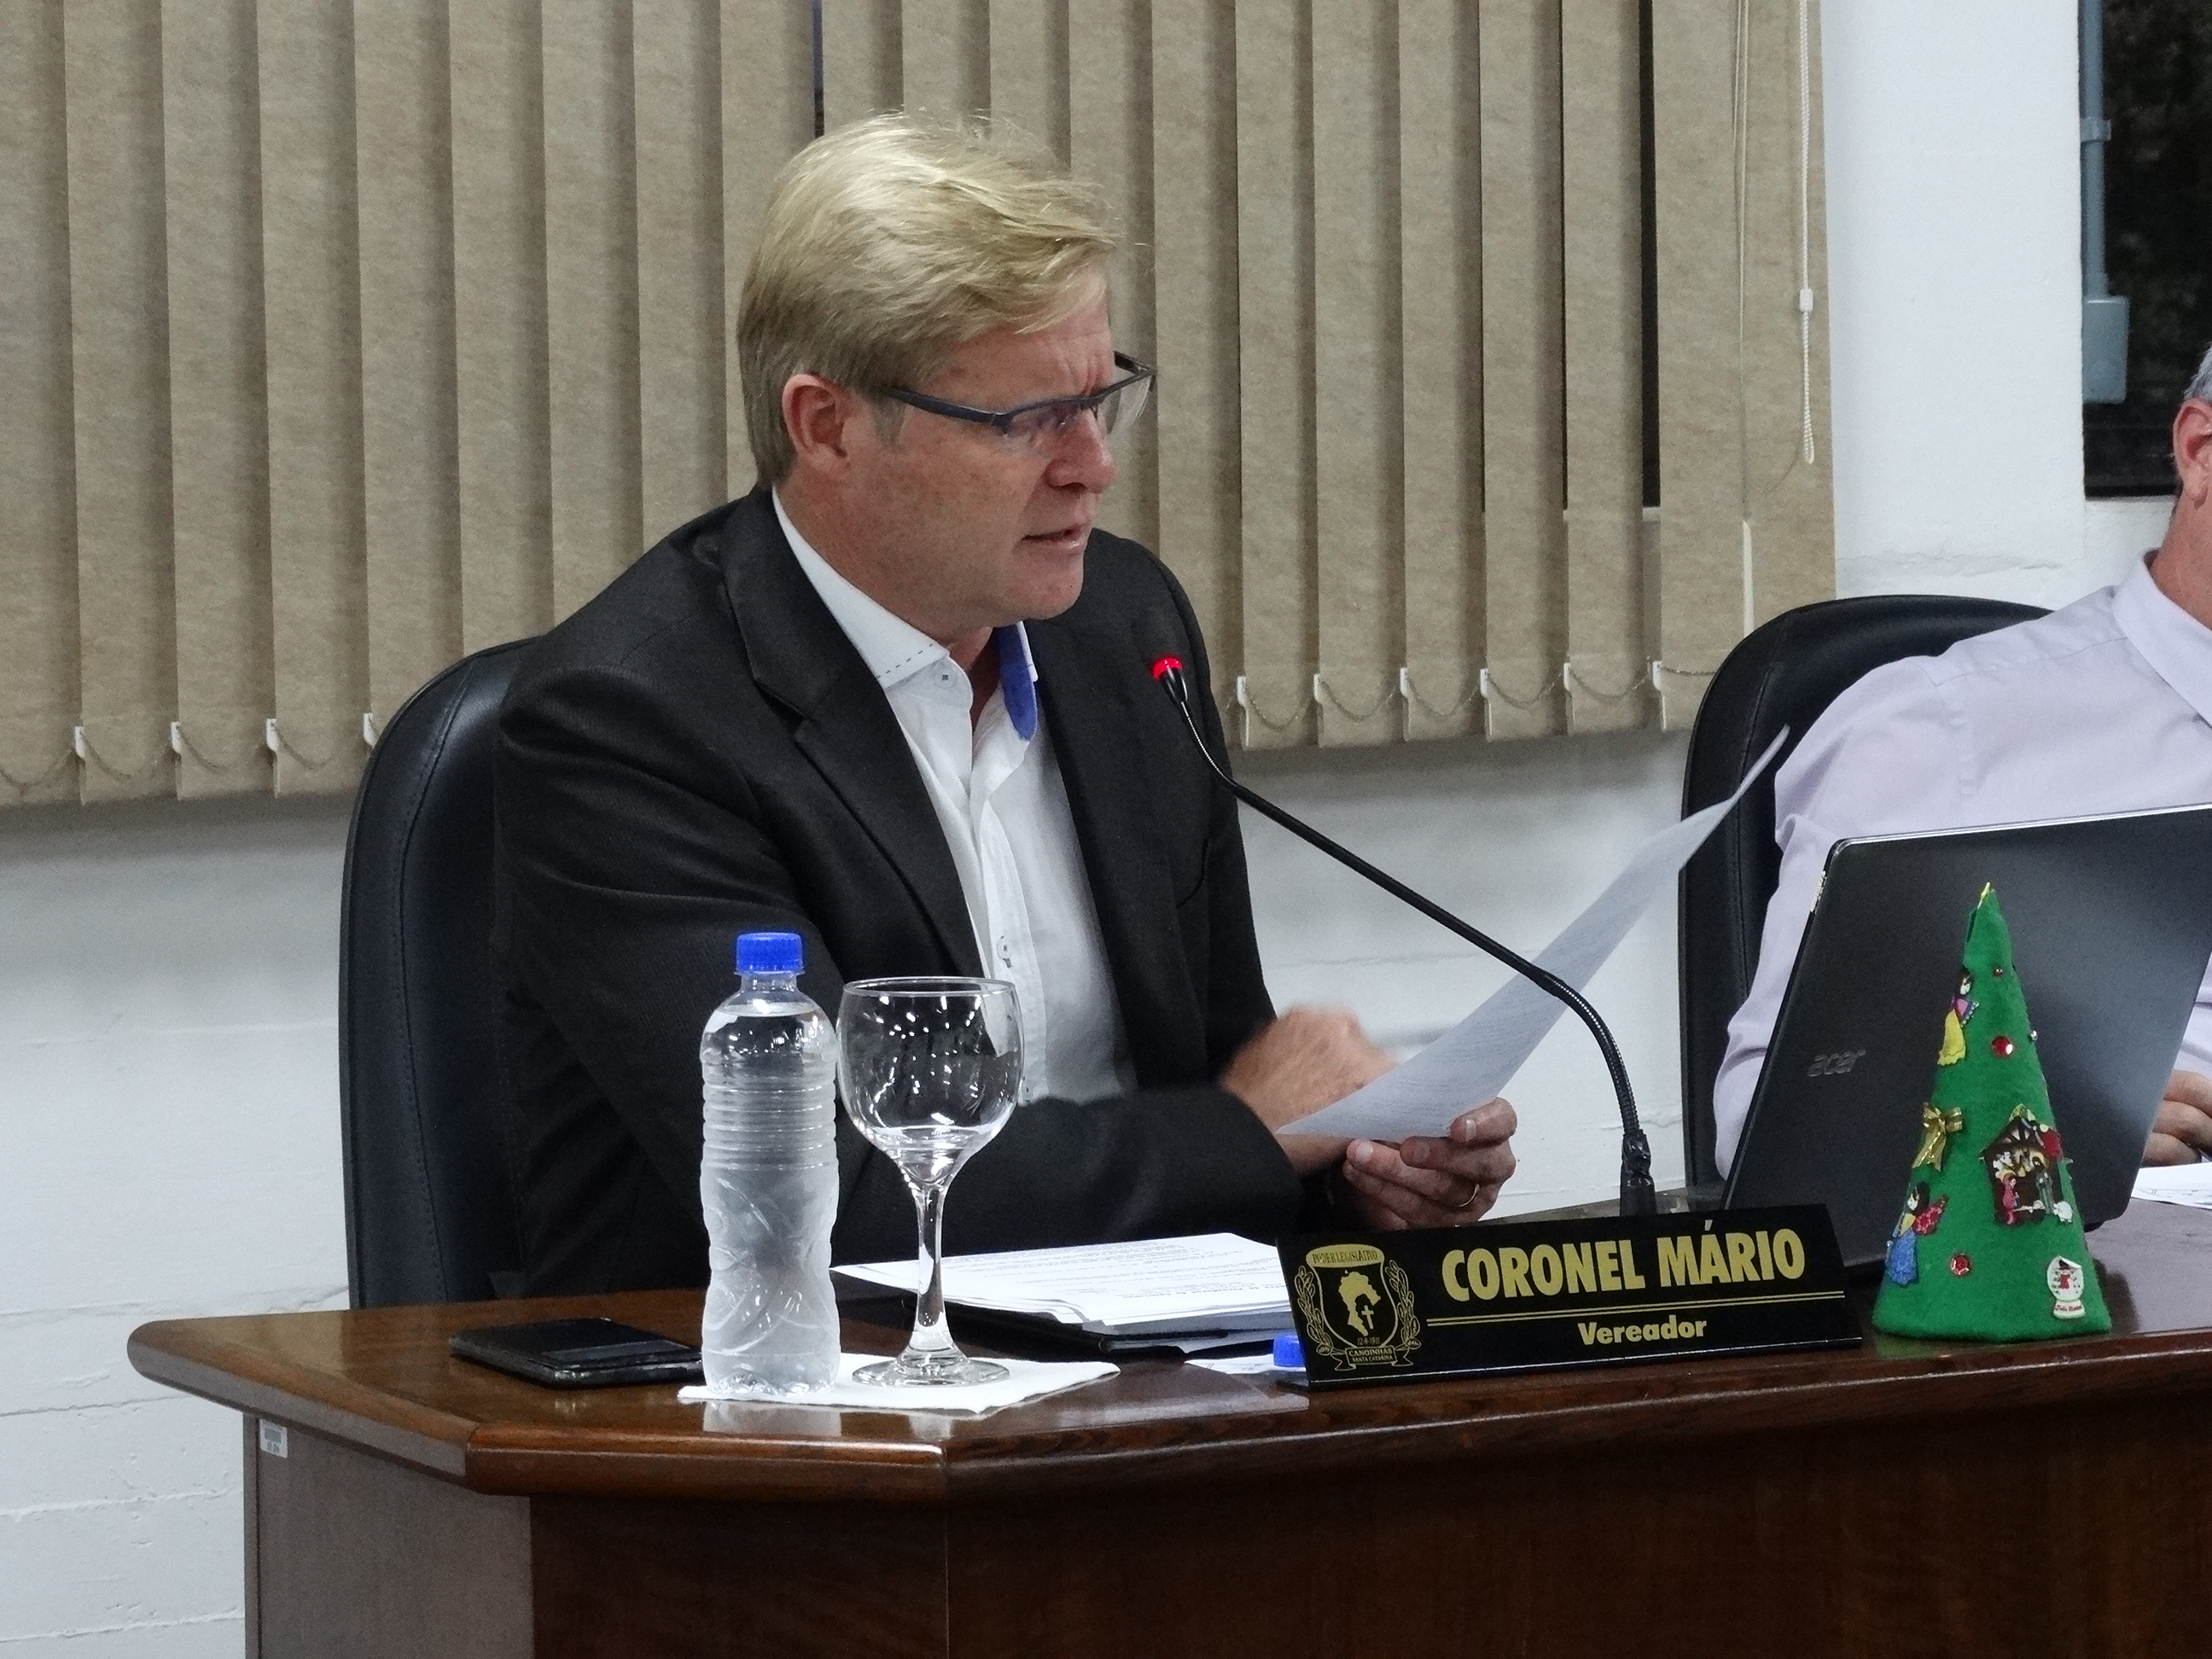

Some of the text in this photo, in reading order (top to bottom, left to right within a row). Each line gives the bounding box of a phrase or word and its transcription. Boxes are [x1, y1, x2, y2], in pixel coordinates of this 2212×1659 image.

[1807, 1049, 1866, 1077] acer
[1441, 1220, 1805, 1302] CORONEL MÁRIO
[1578, 1314, 1707, 1346] Vereador
[1348, 1348, 1393, 1357] CANOINHAS
